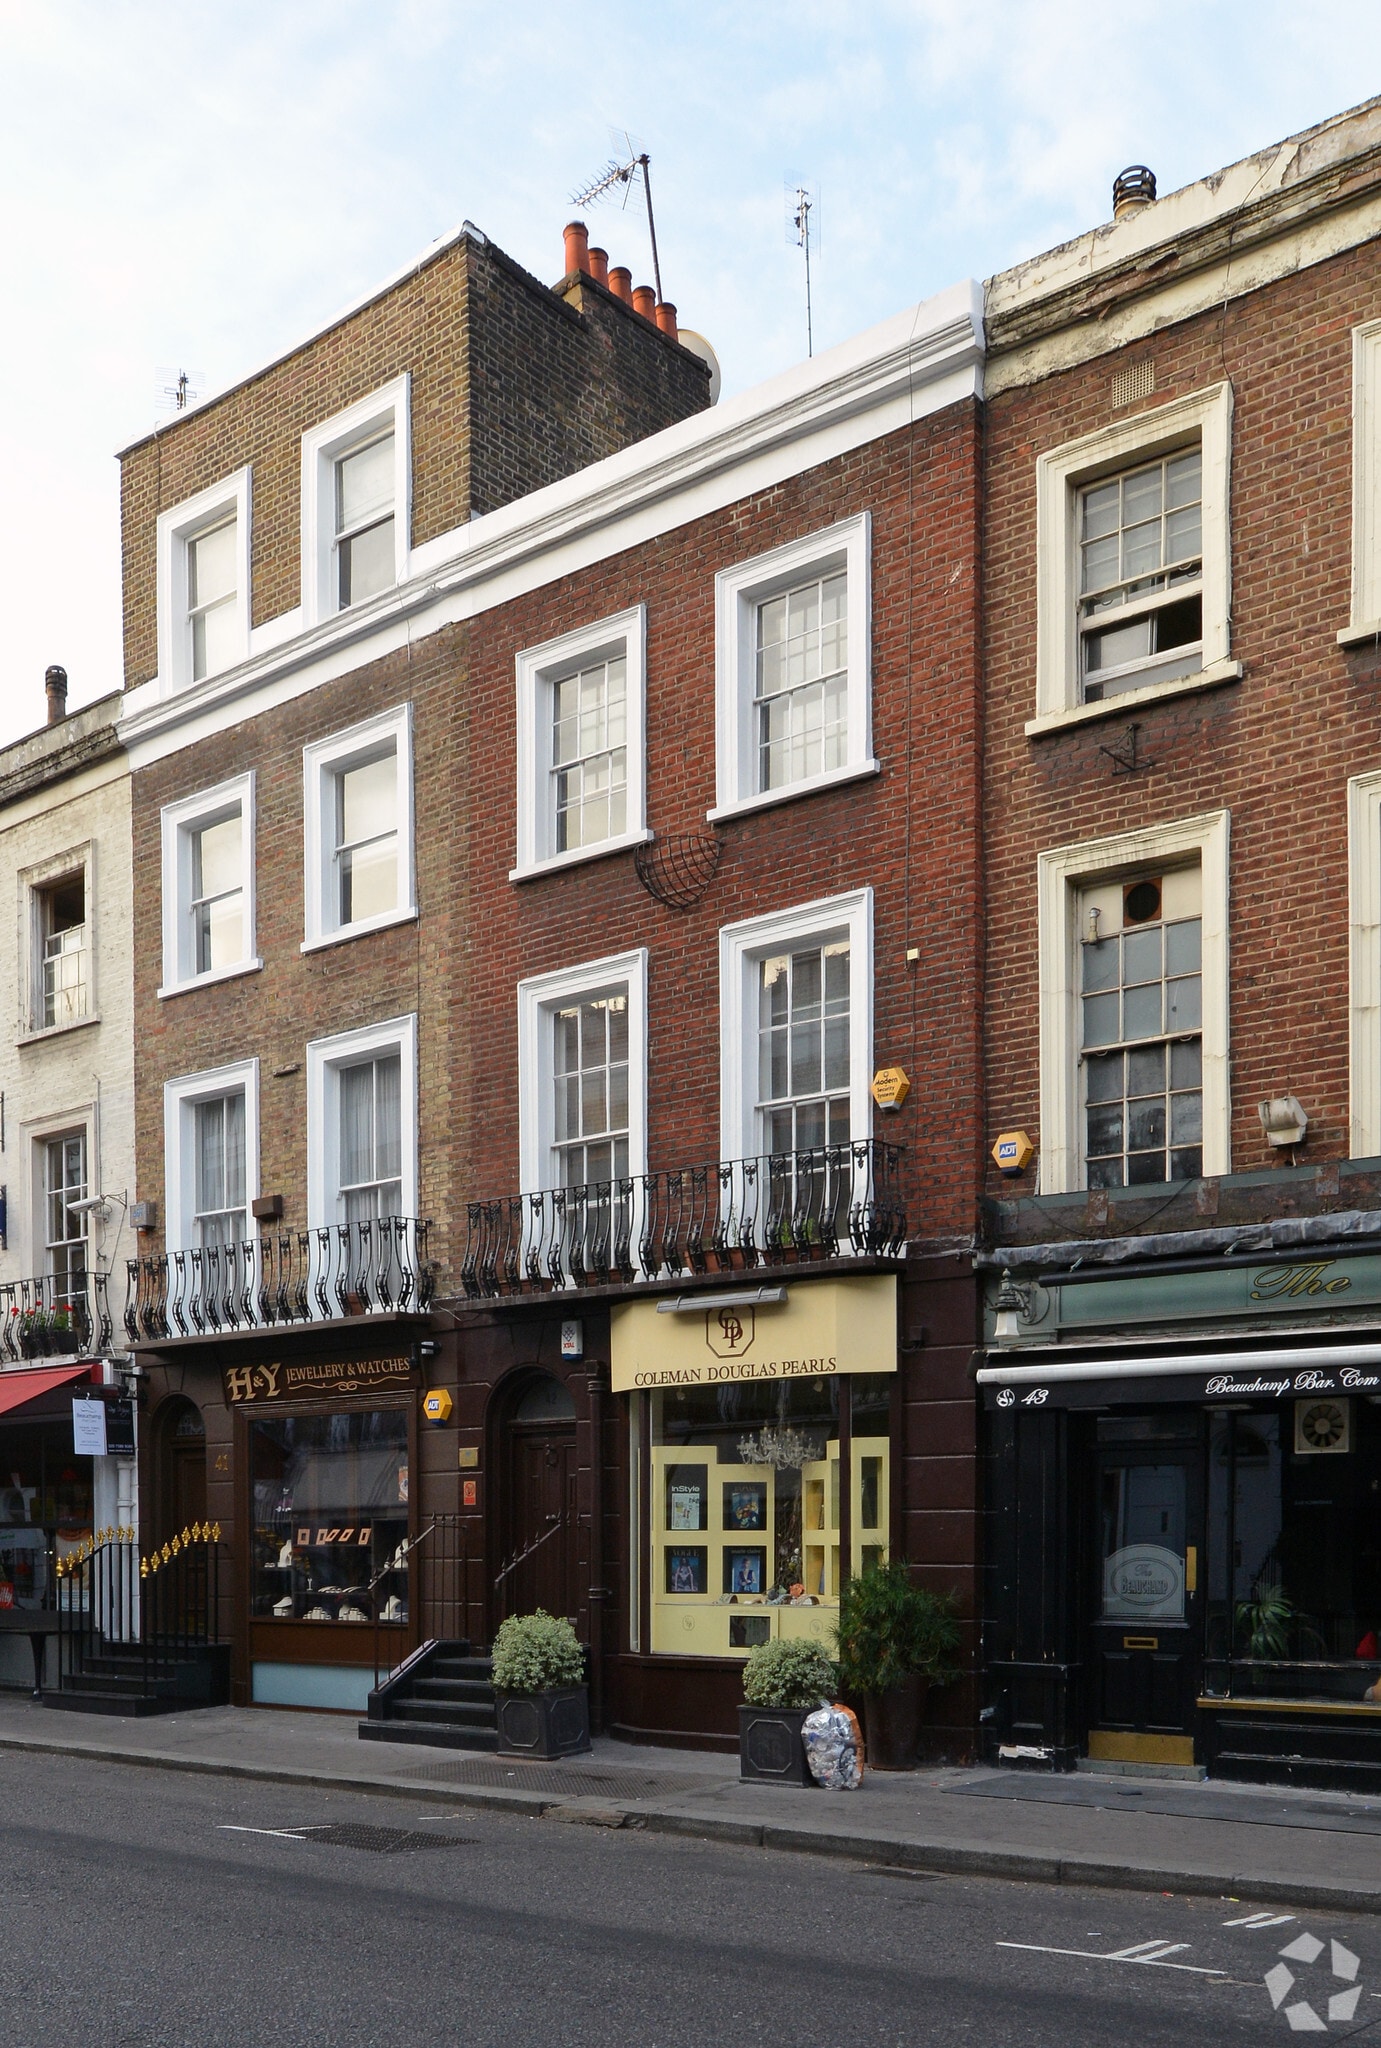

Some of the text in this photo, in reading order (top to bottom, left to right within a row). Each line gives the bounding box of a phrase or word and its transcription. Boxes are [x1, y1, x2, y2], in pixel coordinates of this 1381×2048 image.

[1000, 1144, 1016, 1156] ADT
[1251, 1260, 1351, 1299] The
[286, 1357, 410, 1384] JEWELLERY & WATCHES
[634, 1357, 837, 1386] COLEMAN DOUGLAS PEARLS
[1205, 1367, 1380, 1397] Beauchamp Bar. Com
[428, 1400, 440, 1410] ADT
[1021, 1388, 1049, 1405] 43
[671, 1485, 700, 1493] InStyle
